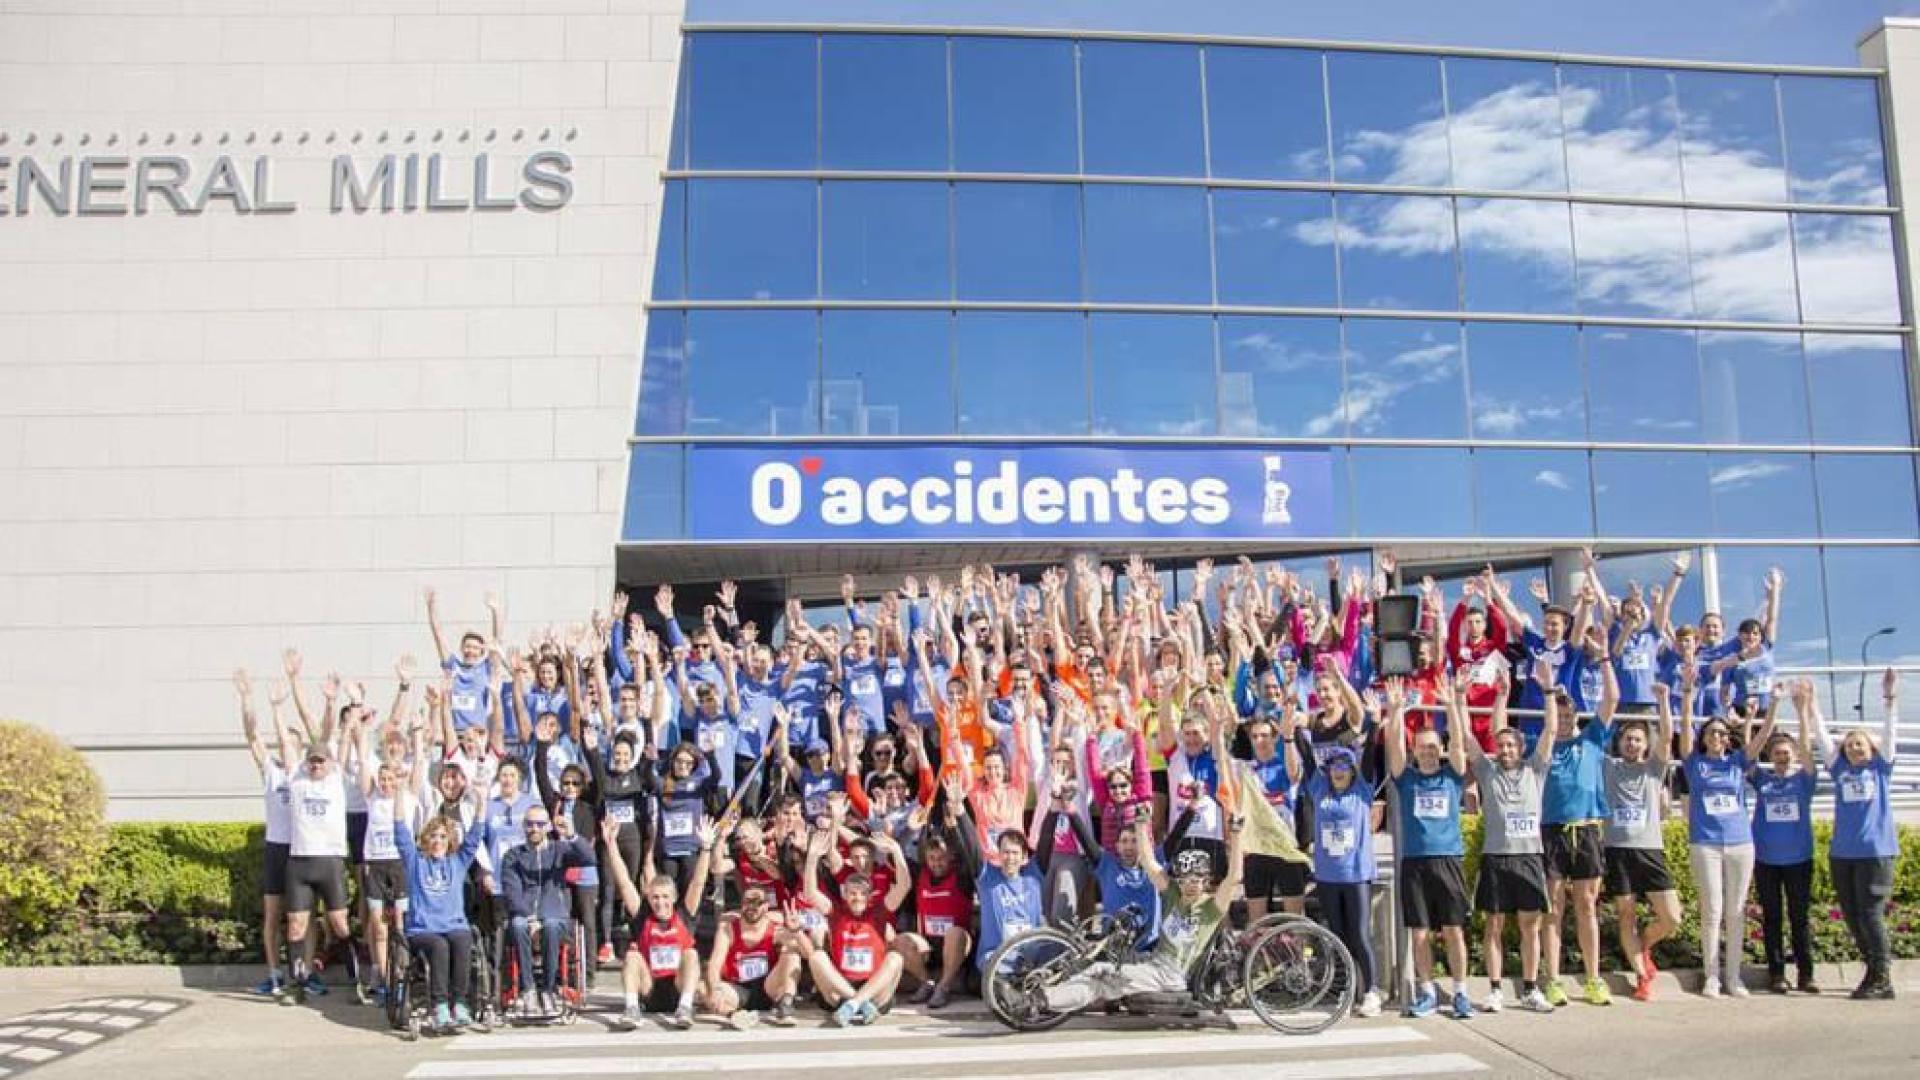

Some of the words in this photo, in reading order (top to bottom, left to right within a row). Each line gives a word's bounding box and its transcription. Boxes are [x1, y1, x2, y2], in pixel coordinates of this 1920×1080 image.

[0, 154, 297, 217] NERAL
[330, 151, 574, 214] MILLS
[820, 460, 1232, 526] accidentes
[1511, 819, 1534, 831] 101
